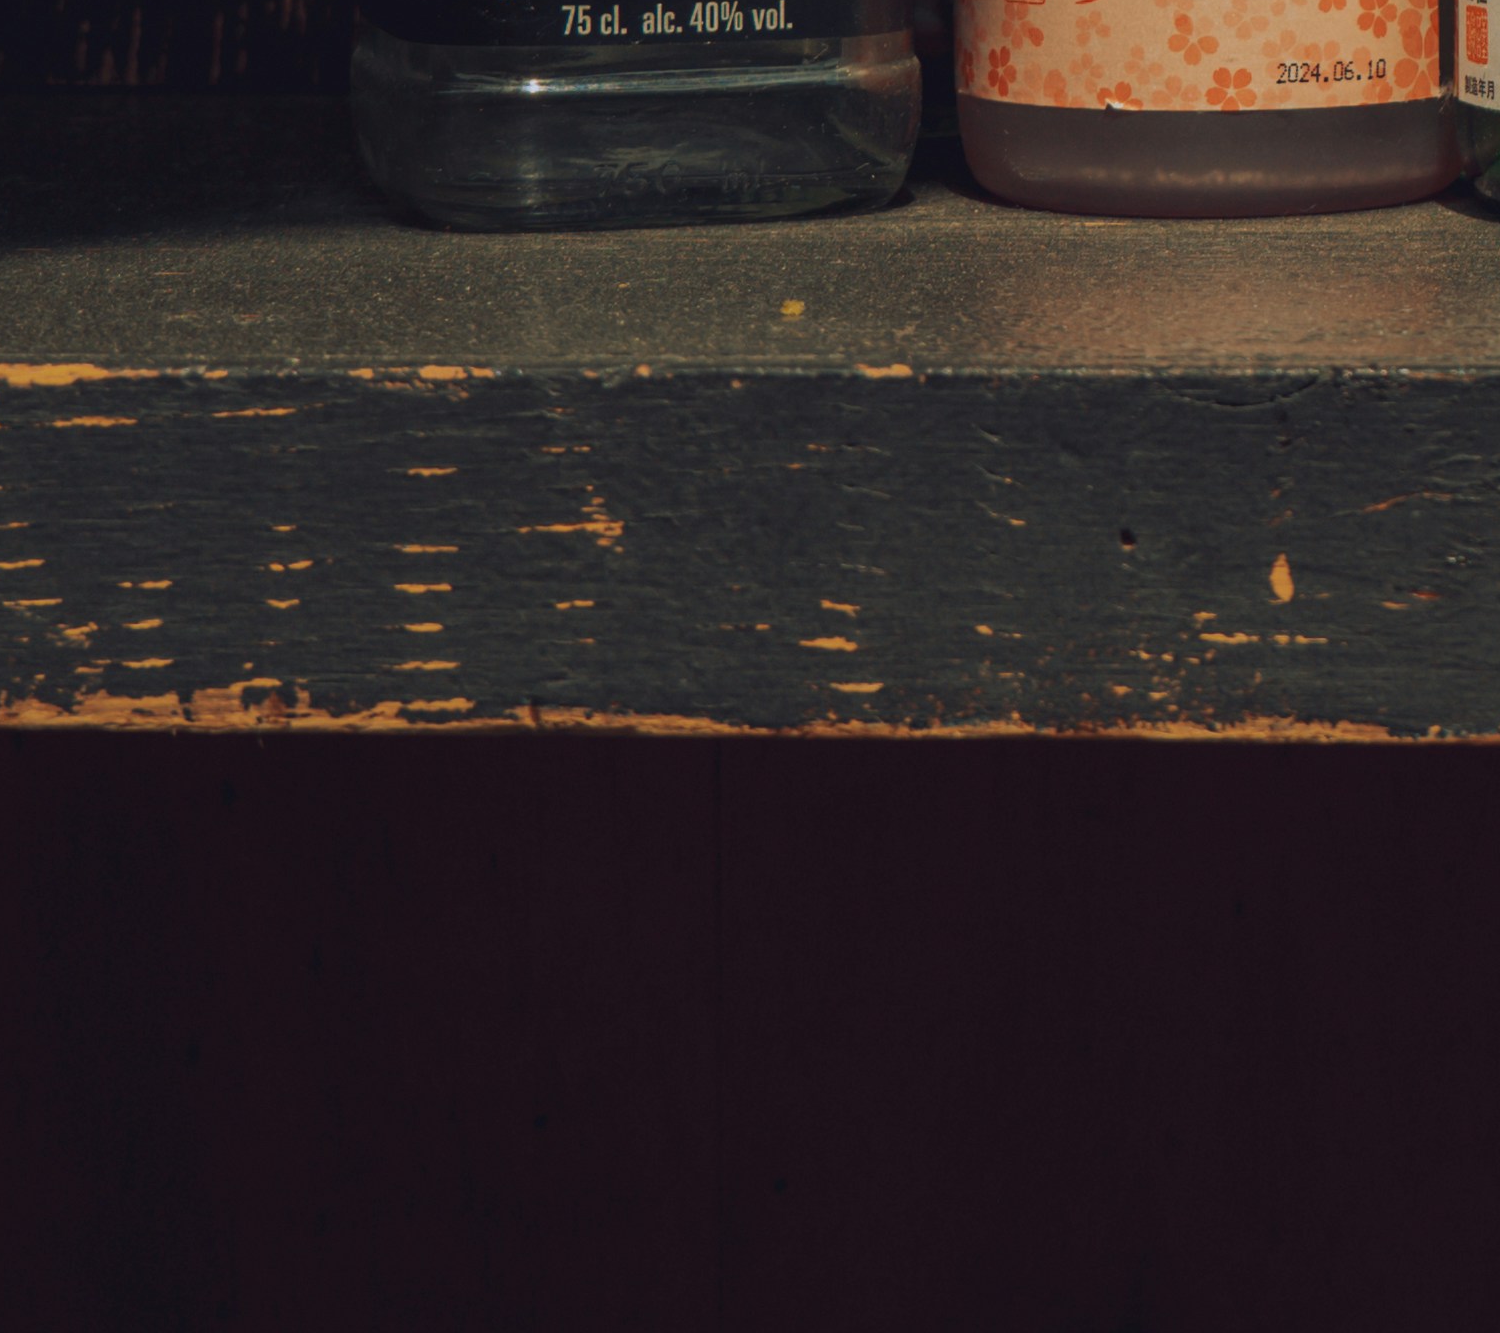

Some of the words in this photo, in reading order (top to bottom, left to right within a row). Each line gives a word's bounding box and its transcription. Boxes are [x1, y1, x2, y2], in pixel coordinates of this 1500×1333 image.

[561, 4, 592, 36] 75
[642, 3, 683, 34] alc.
[689, 1, 744, 33] 40%
[1276, 58, 1387, 85] 2024.06.10
